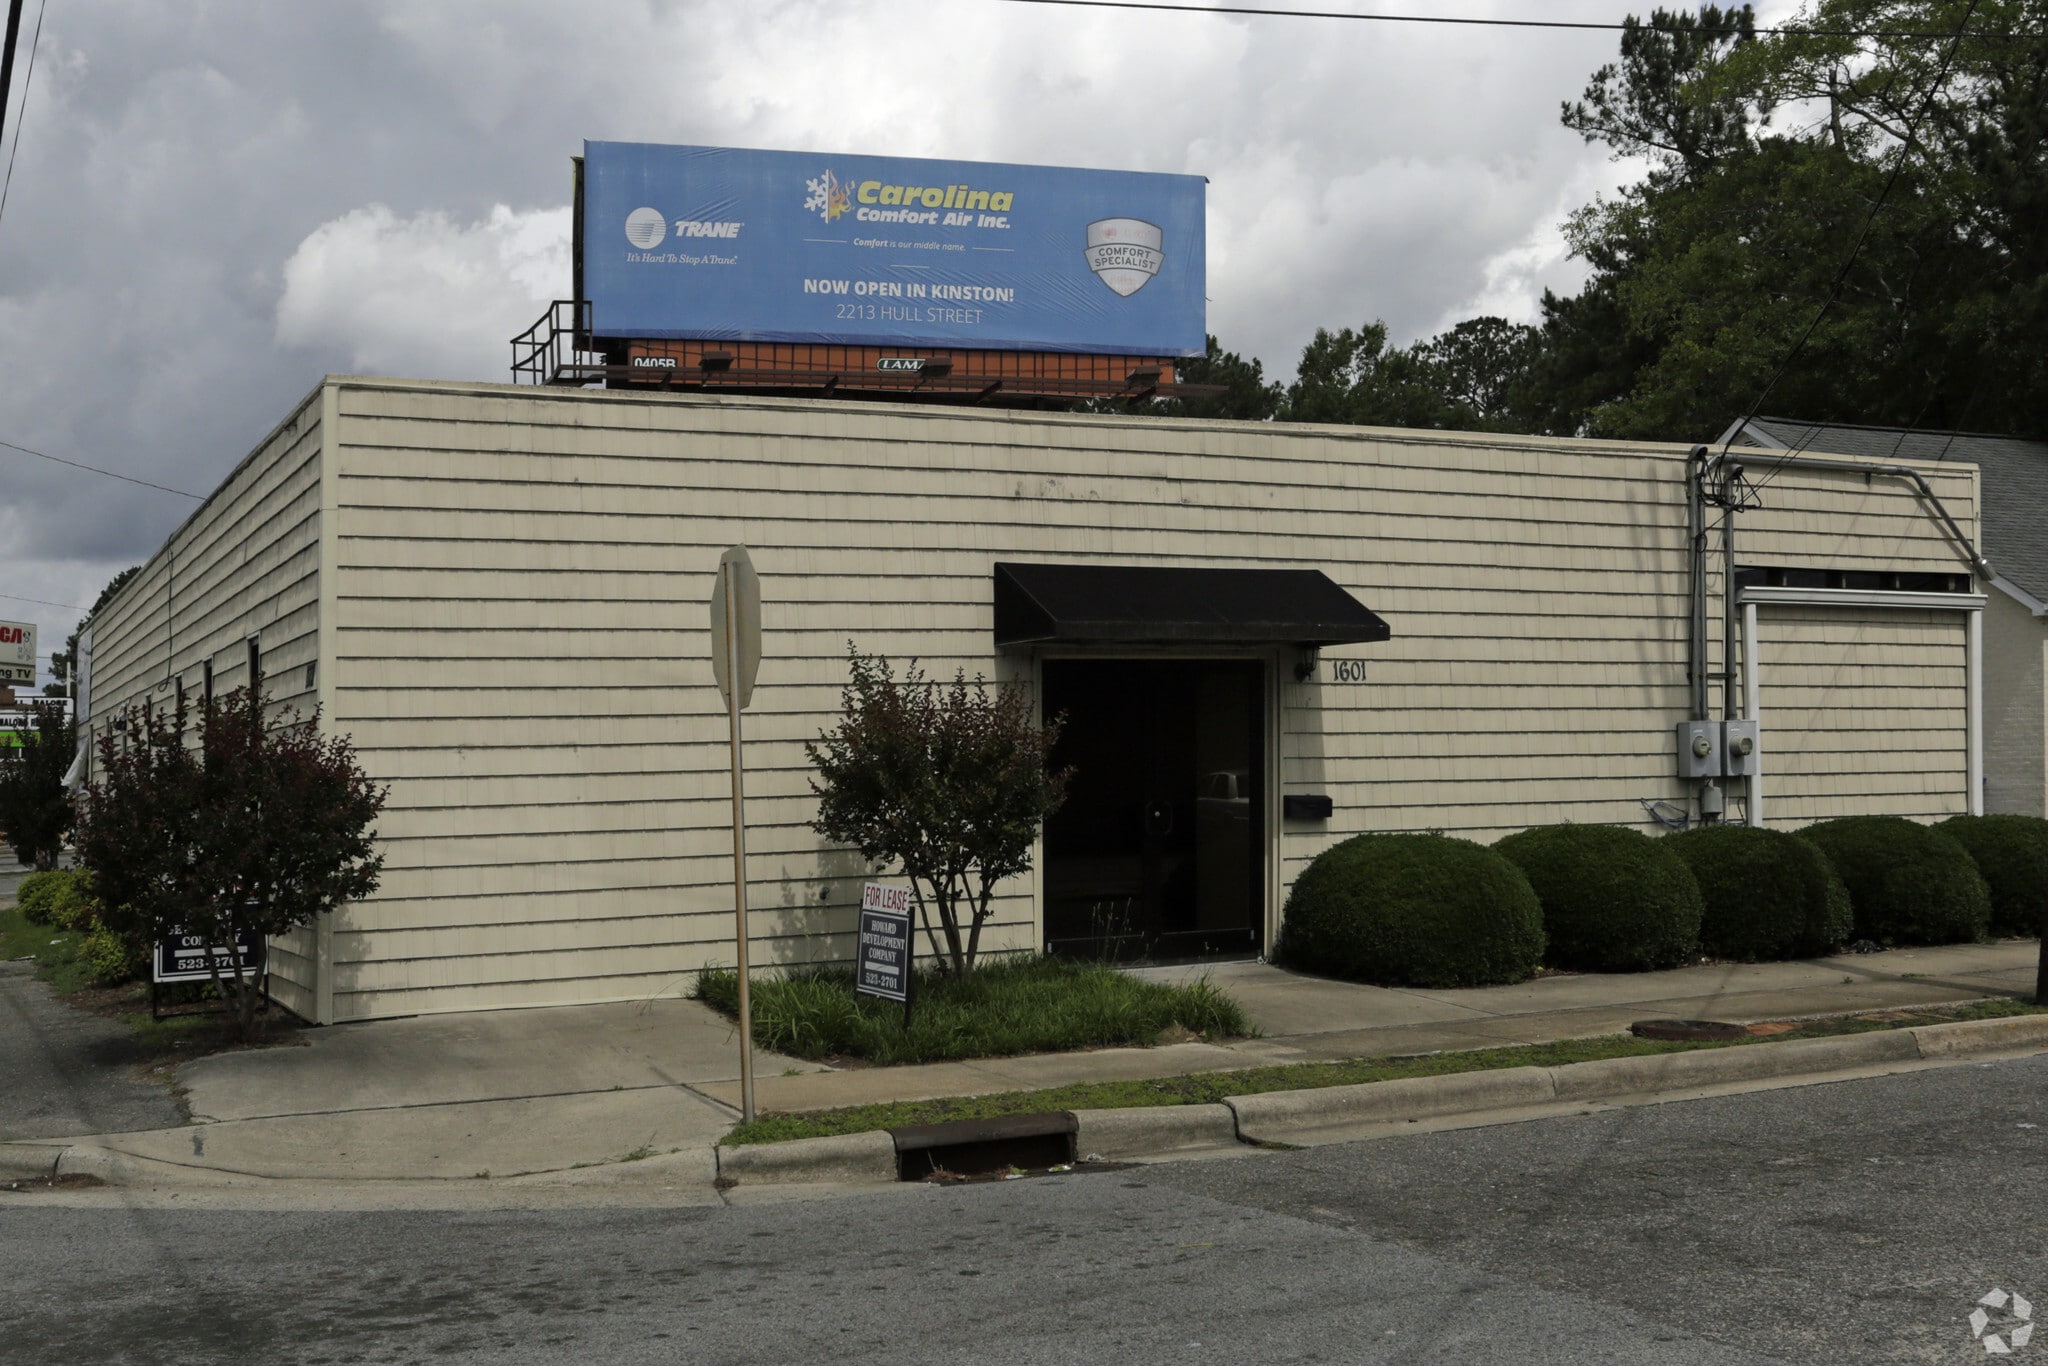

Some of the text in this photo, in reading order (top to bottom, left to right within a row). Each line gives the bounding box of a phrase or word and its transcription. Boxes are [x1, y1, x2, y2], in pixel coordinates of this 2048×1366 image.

[857, 180, 1014, 212] Carolina
[856, 207, 1011, 229] Comfort Air Inc.
[675, 220, 741, 238] TRANE
[853, 237, 888, 248] Comfort
[890, 240, 896, 248] is
[914, 241, 940, 250] middle
[642, 252, 665, 262] Hard
[667, 253, 678, 262] To
[679, 253, 700, 266] Stop
[701, 254, 709, 264] A
[1098, 247, 1151, 259] COMFORT
[1094, 256, 1156, 270] SPECIALIST
[804, 278, 1014, 302] NOW OPEN IN KINSTON!
[836, 304, 983, 324] 2213 HULL STREET
[16, 668, 31, 679] TV
[1333, 661, 1366, 681] 1601
[865, 886, 908, 911] FOR LEASE
[862, 932, 905, 950] DEVELOPMENT
[868, 947, 897, 962] COMPANY
[865, 972, 897, 989] 523-2701
